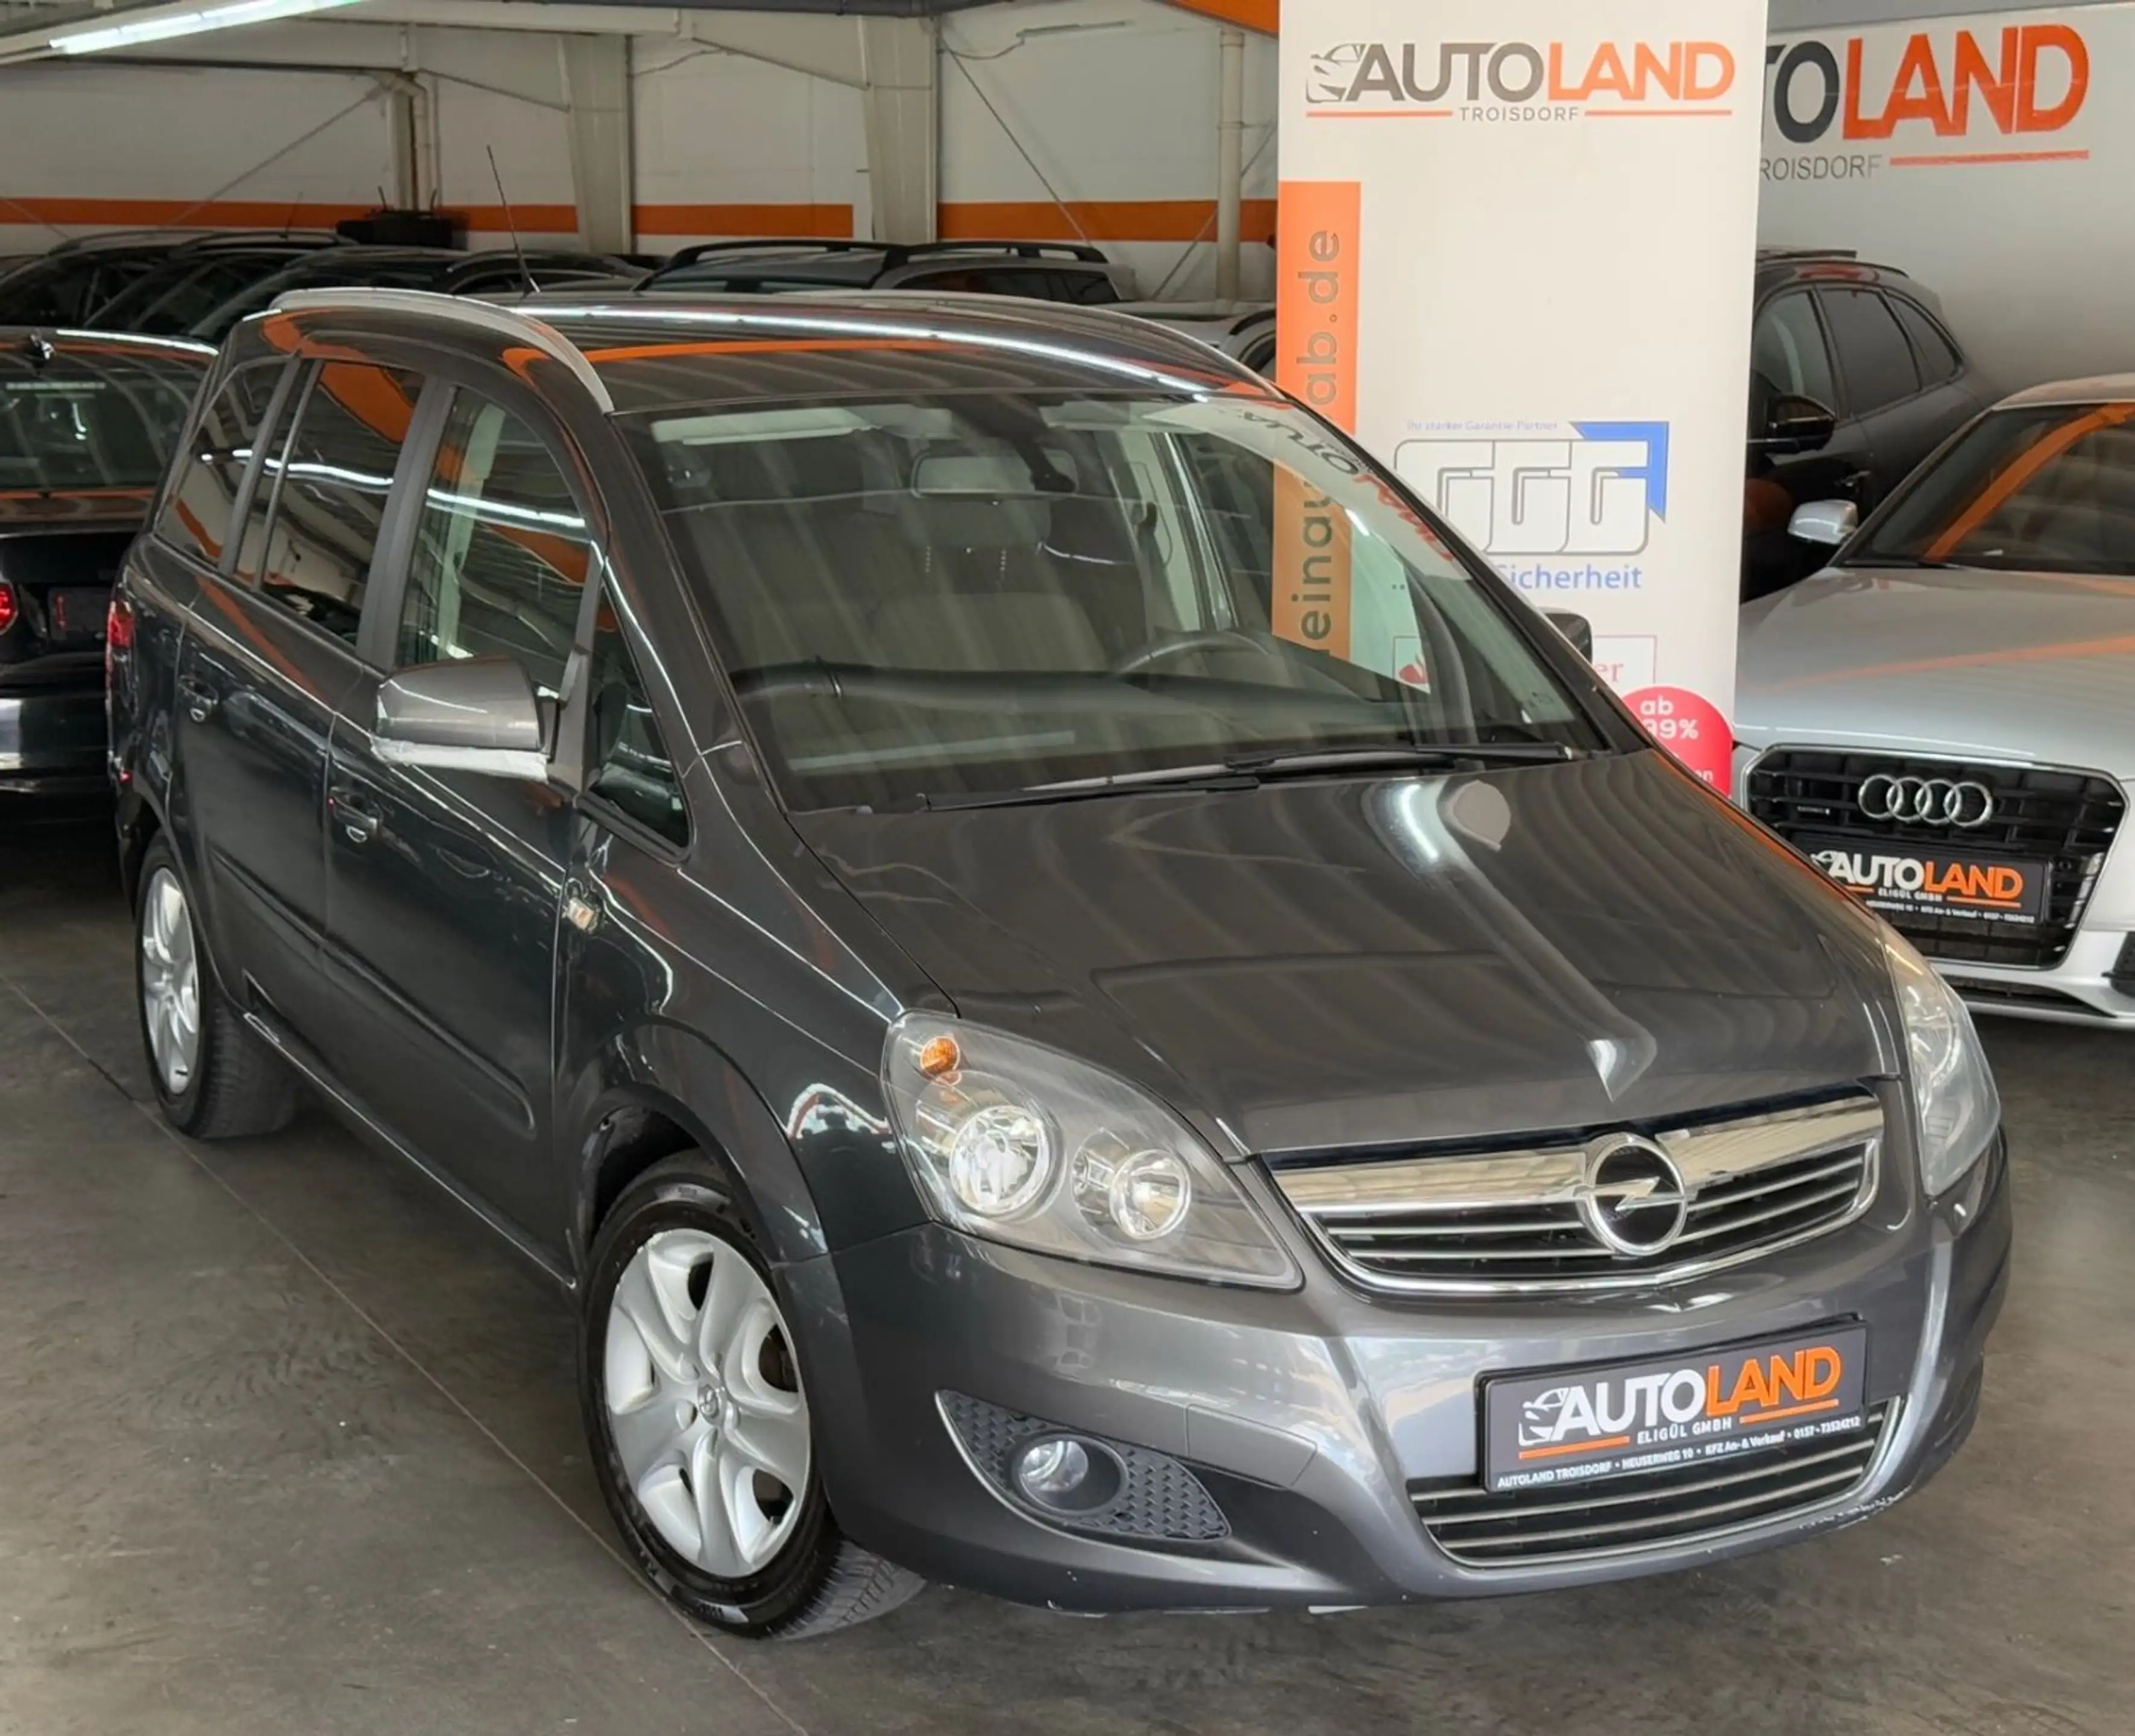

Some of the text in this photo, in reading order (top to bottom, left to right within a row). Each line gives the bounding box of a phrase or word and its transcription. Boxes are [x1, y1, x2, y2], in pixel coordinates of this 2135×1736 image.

[1345, 41, 1735, 102] AUTOLAND
[1765, 24, 2089, 143] OLAND
[1459, 107, 1580, 122] TROISDORF
[1759, 154, 1882, 181] ROISDORF
[1495, 564, 1643, 590] icherheit
[1640, 695, 1674, 715] ab
[1642, 718, 1699, 740] 99%
[1828, 851, 2024, 899] AUTOLAND
[1550, 1345, 1842, 1442] AUTOLAND
[1691, 1416, 1732, 1435] GMBH
[1497, 1470, 1555, 1488] AUTOLAND
[1555, 1461, 1612, 1480] TROISDORF
